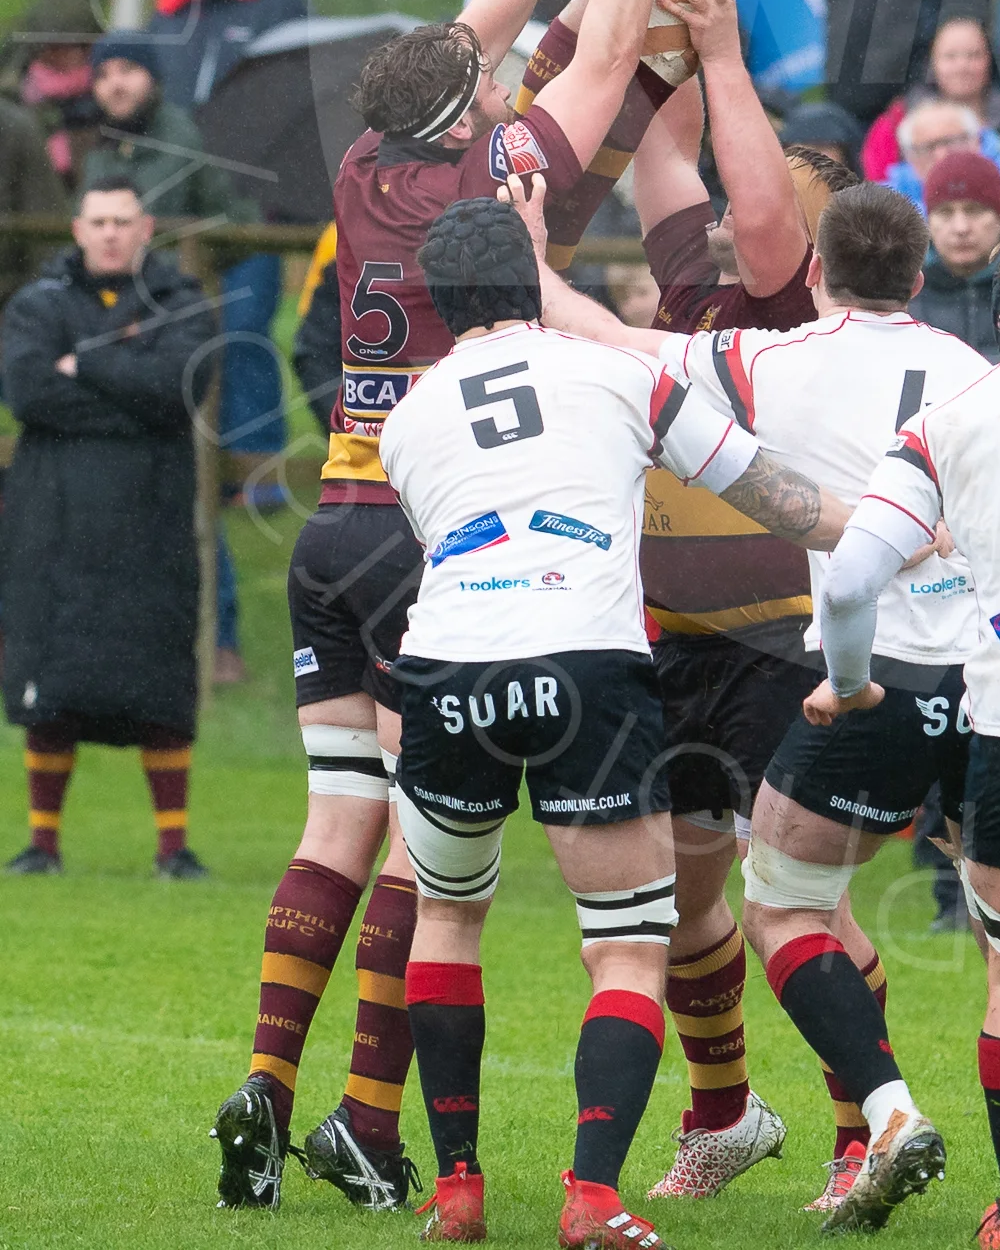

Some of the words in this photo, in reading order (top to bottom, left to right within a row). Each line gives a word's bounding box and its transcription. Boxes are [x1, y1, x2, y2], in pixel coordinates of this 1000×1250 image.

[346, 261, 410, 362] 5
[345, 379, 398, 405] BCA
[459, 360, 545, 450] 5
[413, 785, 503, 813] SOARONLINE.CO.UK
[539, 793, 632, 813] SOARONLINE.CO.UK
